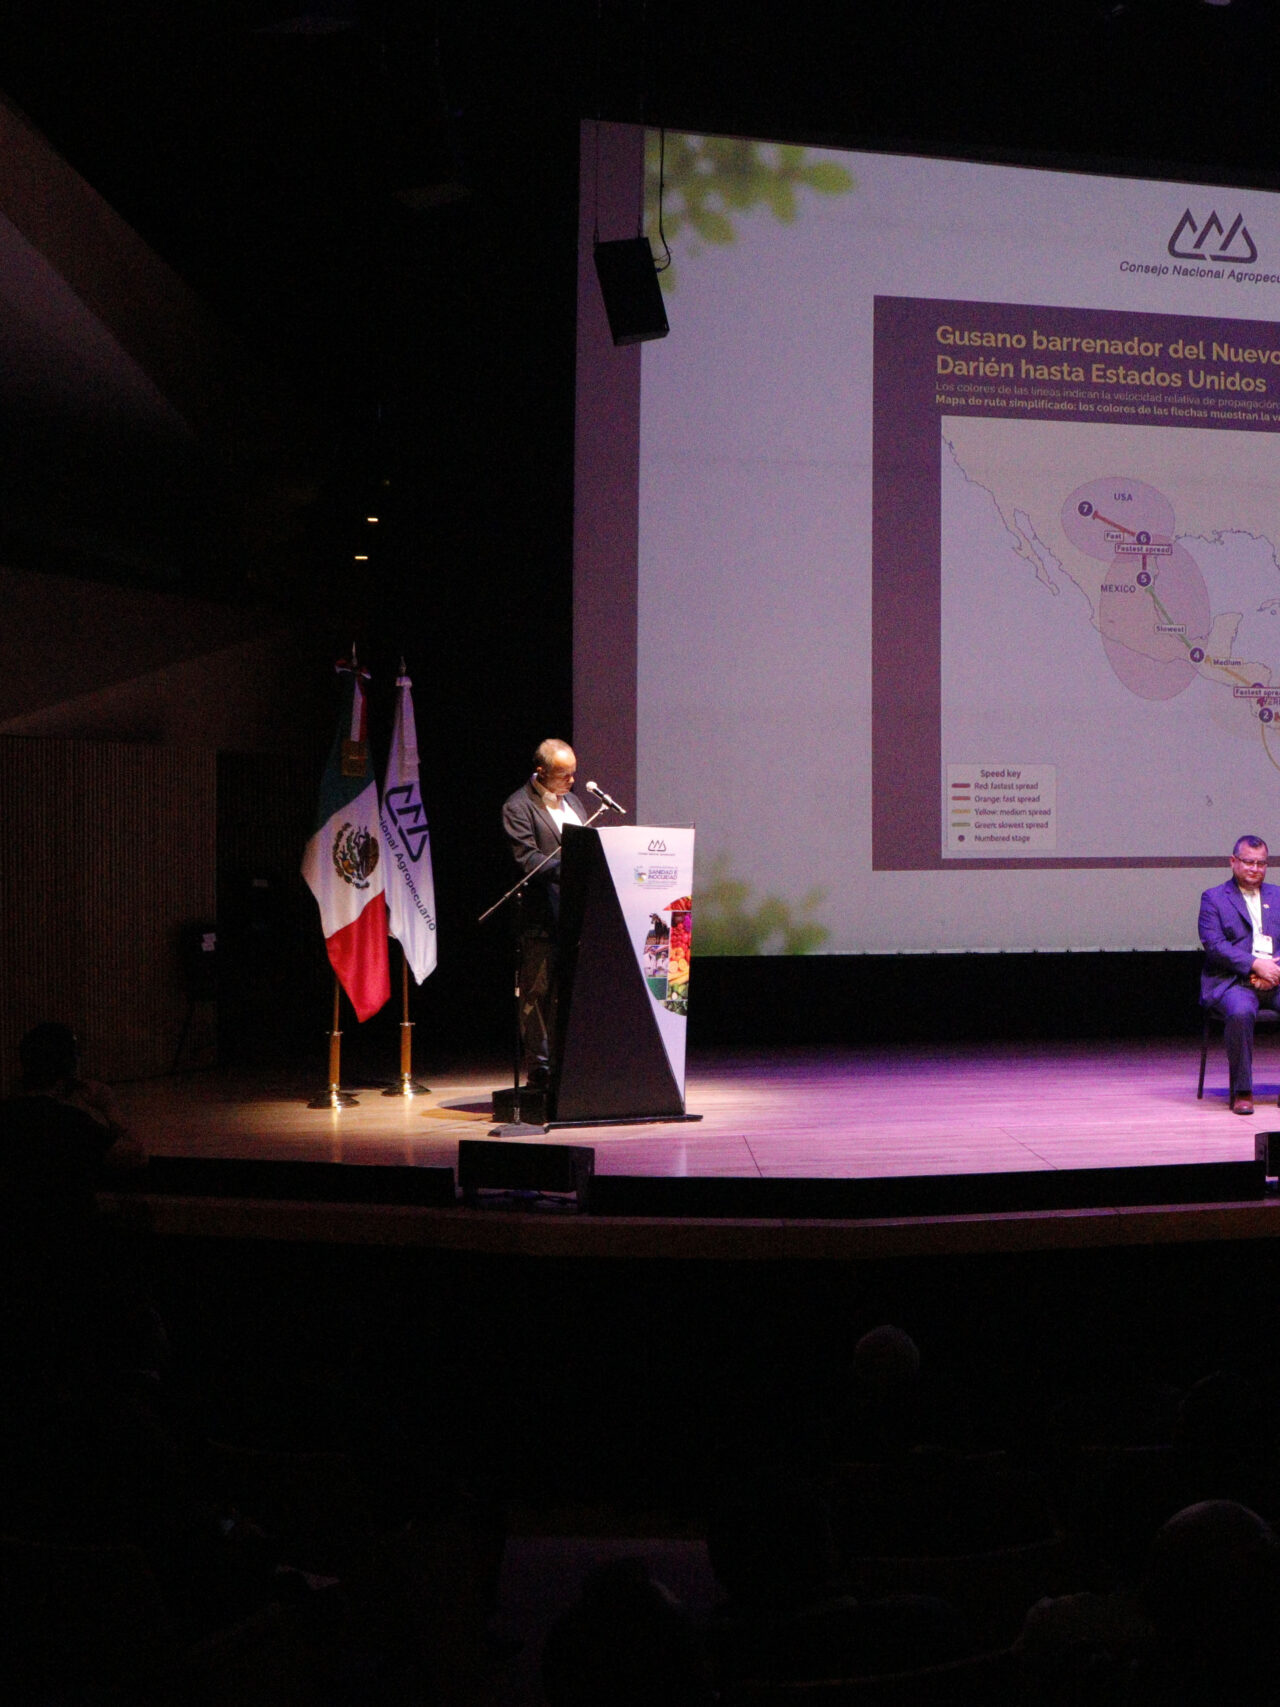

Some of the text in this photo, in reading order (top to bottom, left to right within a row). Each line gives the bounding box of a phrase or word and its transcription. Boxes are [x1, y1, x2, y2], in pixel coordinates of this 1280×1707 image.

[1120, 261, 1169, 277] Consejo
[1172, 265, 1224, 279] Nacional
[936, 326, 1026, 349] Gusano
[1033, 331, 1163, 357] barrenador
[1169, 340, 1205, 360] del
[936, 355, 1267, 392] Darién hasta Estados Unidos
[935, 381, 954, 391] Los
[956, 383, 995, 393] colores
[997, 385, 1011, 394] de
[1013, 386, 1028, 395] las
[1062, 388, 1099, 399] indican
[1101, 390, 1111, 400] la
[1113, 392, 1161, 402] velocidad
[1164, 394, 1200, 405] relativa
[1202, 396, 1215, 405] de
[935, 394, 965, 406] Mapa
[968, 396, 982, 406] de
[984, 397, 1006, 407] ruta
[1009, 398, 1076, 411] simplificado:
[1078, 402, 1094, 412] los
[1096, 404, 1135, 414] colores
[1137, 405, 1151, 415] de
[1153, 406, 1168, 416] las
[1170, 407, 1207, 418] flechas
[1210, 410, 1258, 421] muestran
[1260, 412, 1270, 421] la
[1114, 493, 1132, 501] USA
[980, 769, 1021, 779] Speed key
[395, 852, 436, 931] Agropecuario
